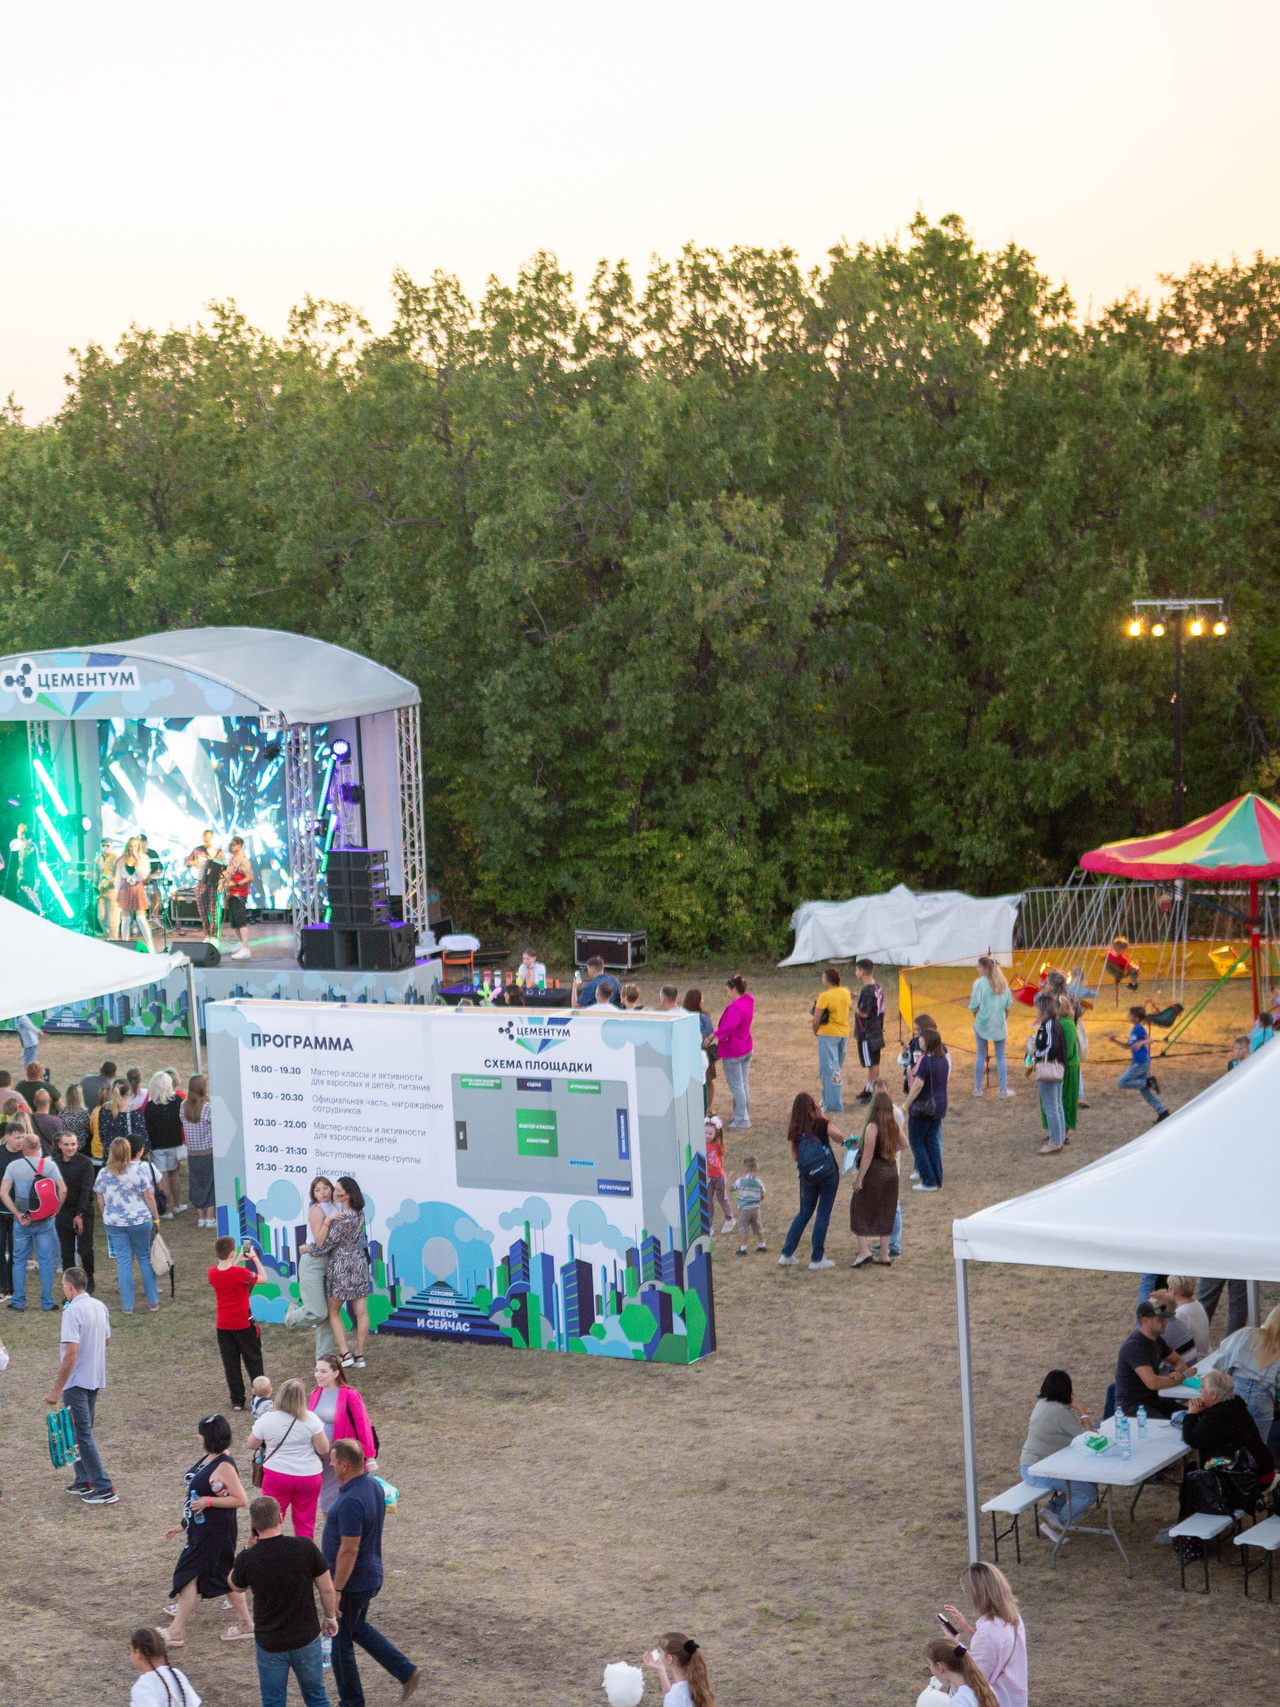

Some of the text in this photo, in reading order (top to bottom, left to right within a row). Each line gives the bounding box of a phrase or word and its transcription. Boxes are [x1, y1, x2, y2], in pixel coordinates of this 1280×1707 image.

[38, 671, 135, 690] ЦЕМЕНТУМ
[516, 1027, 570, 1037] ЦЕМЕНТУМ
[250, 1033, 354, 1052] ПРОГРАММА
[250, 1065, 272, 1073] 18.00
[280, 1066, 301, 1075] 19.30
[484, 1059, 592, 1073] СХЕМА ПЛОЩАДКИ
[311, 1068, 369, 1078] Мастер-классы
[379, 1073, 422, 1081] активности
[372, 1081, 396, 1090] детей,
[252, 1092, 273, 1100] 19.30
[281, 1093, 304, 1102] 20.30
[312, 1095, 444, 1111] Официальная часть, награждение
[313, 1106, 361, 1115] сотрудников
[254, 1119, 276, 1127] 20.30
[284, 1120, 307, 1129] 22.00
[314, 1122, 372, 1134] Мастер-классы
[381, 1128, 426, 1136] активности
[314, 1133, 327, 1141] для
[330, 1134, 365, 1143] взрослых
[375, 1136, 397, 1144] детей
[254, 1145, 278, 1153] 20:30
[285, 1146, 307, 1155] 21:30
[315, 1149, 420, 1164] Выступление кавер-группы
[256, 1163, 277, 1172] 21.30
[284, 1165, 307, 1174] 22.00
[316, 1167, 356, 1178] Дискотека
[428, 1308, 459, 1319] ЗДЕСЬ
[416, 1318, 470, 1332] И СЕЙЧАС
